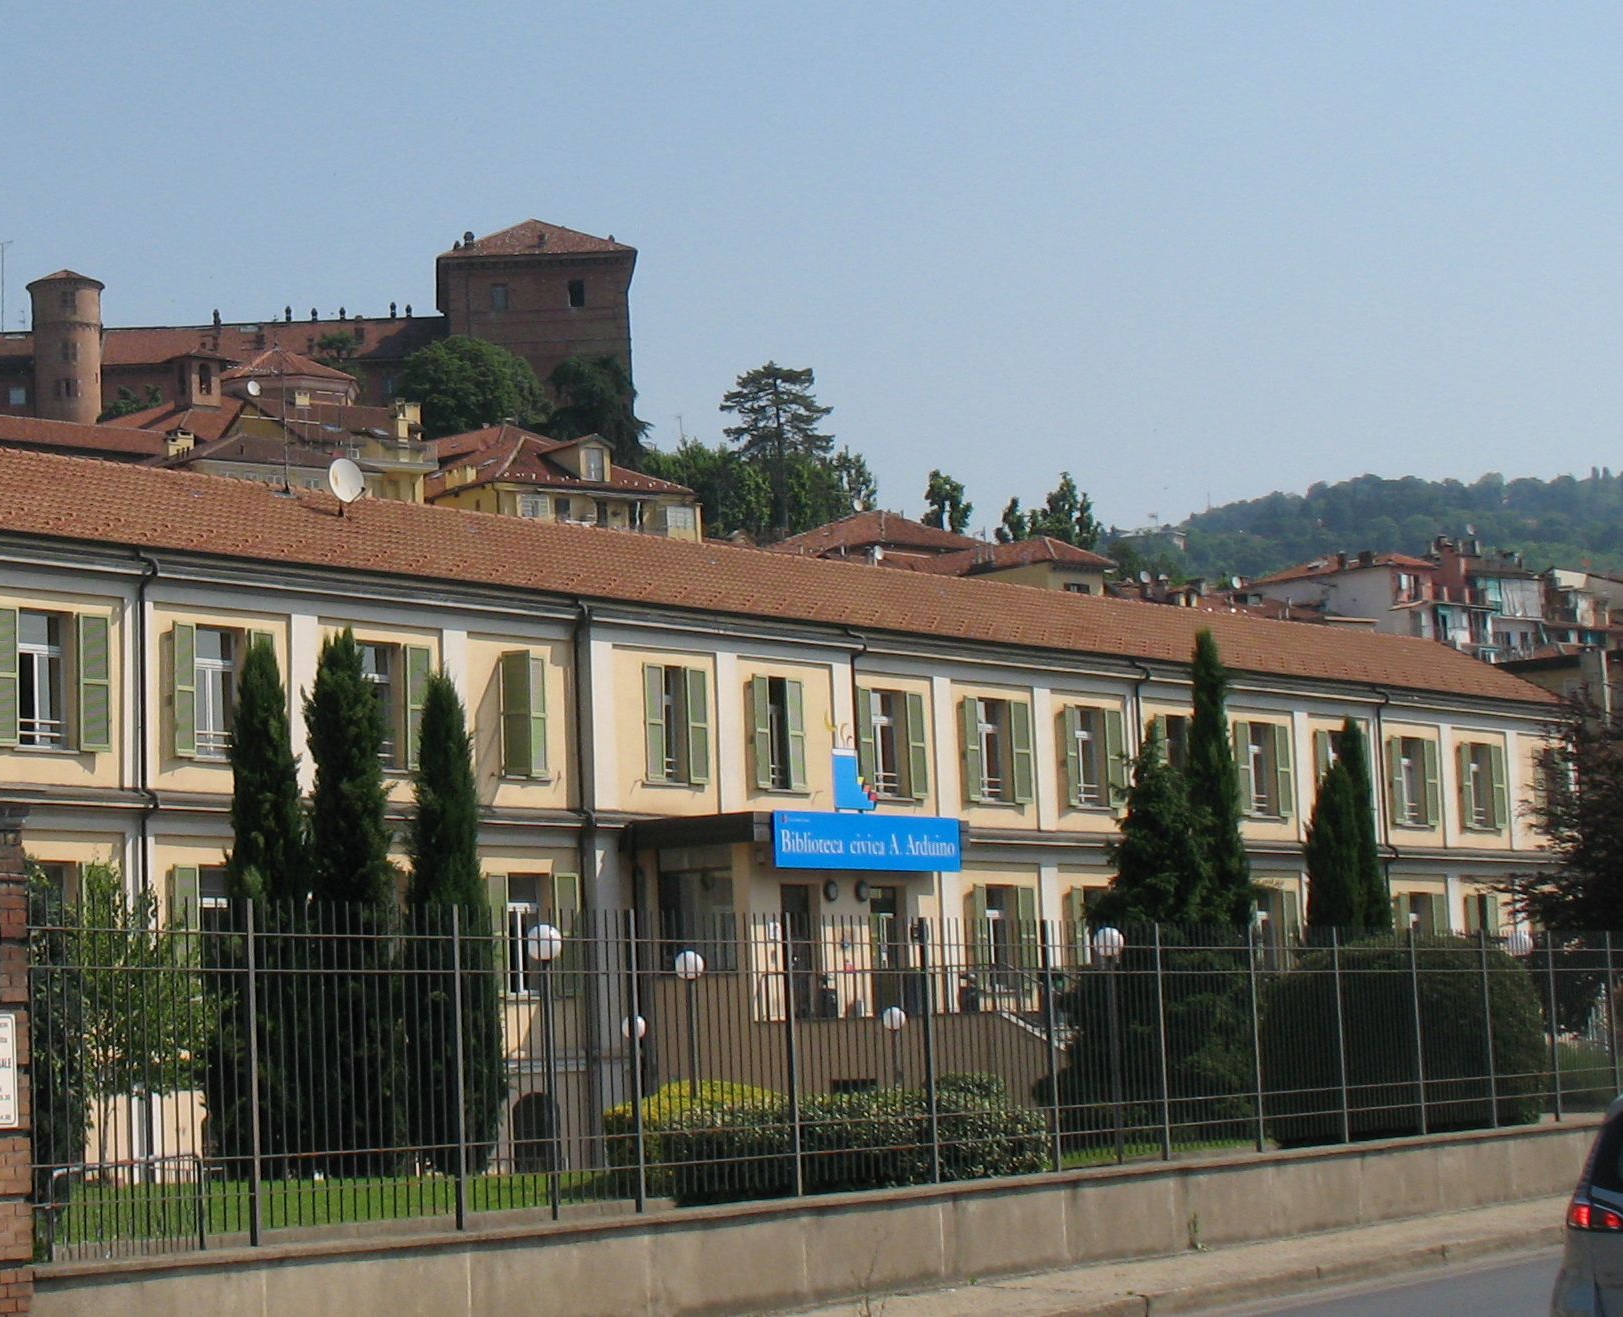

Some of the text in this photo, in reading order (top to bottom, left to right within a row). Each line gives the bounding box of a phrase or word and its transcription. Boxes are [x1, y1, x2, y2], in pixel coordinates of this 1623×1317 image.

[781, 829, 955, 856] Biblioteca civica A. Arduino
